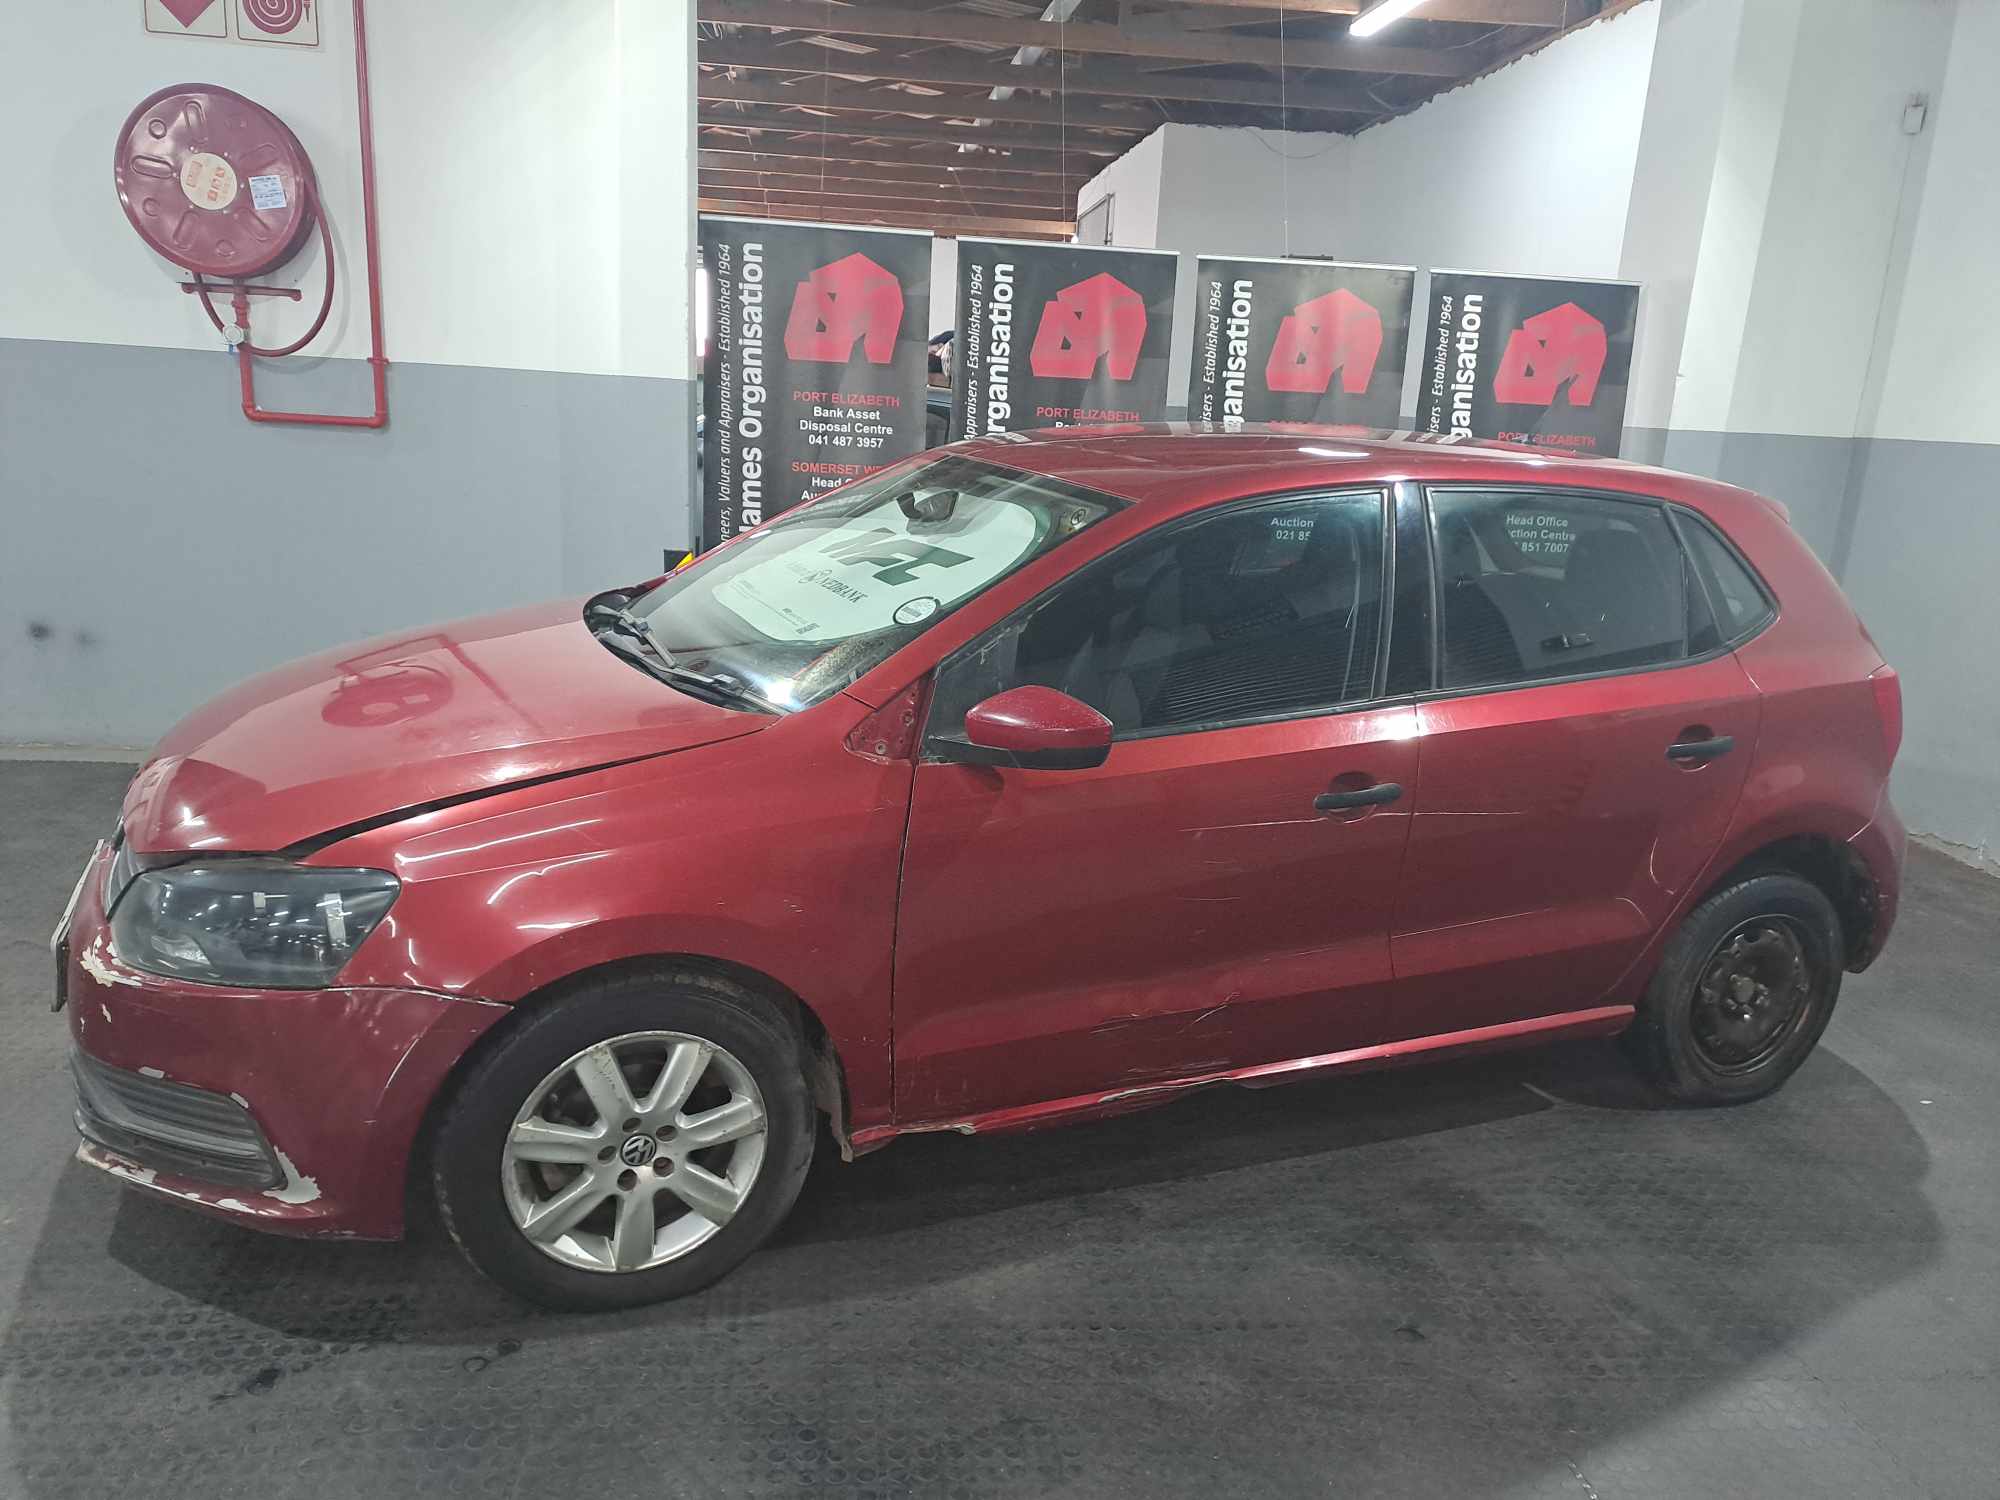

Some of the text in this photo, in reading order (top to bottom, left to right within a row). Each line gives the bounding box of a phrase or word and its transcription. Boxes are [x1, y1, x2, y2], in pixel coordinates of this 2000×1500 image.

[718, 243, 731, 275] 1964
[970, 264, 983, 295] 1964
[1209, 281, 1222, 311] 1964
[717, 278, 731, 352] Established
[1440, 295, 1454, 326] 1964
[738, 242, 767, 438] Organisation
[967, 297, 981, 369] Established
[986, 263, 1014, 435] rganisation
[1203, 313, 1220, 384] Established
[1432, 328, 1450, 396] Established
[718, 362, 733, 428] Appraisers
[793, 390, 900, 408] PORT ELIZABETH
[813, 406, 881, 420] Bank Asset
[1036, 406, 1140, 422] PORT ELIZABETH
[1200, 394, 1213, 424] isers
[799, 420, 893, 435] Disposal Centre
[1498, 431, 1528, 442] POR
[718, 428, 731, 454] and
[808, 434, 884, 448] 041 487 3957
[718, 457, 731, 501] Valuers
[791, 462, 862, 475] SOMERSET
[811, 476, 841, 488] Head
[1270, 517, 1314, 528] Auction
[1505, 514, 1569, 527] Head Office
[1276, 530, 1295, 540] 021
[1508, 529, 1538, 539] ction
[1521, 541, 1569, 552] 851 7007
